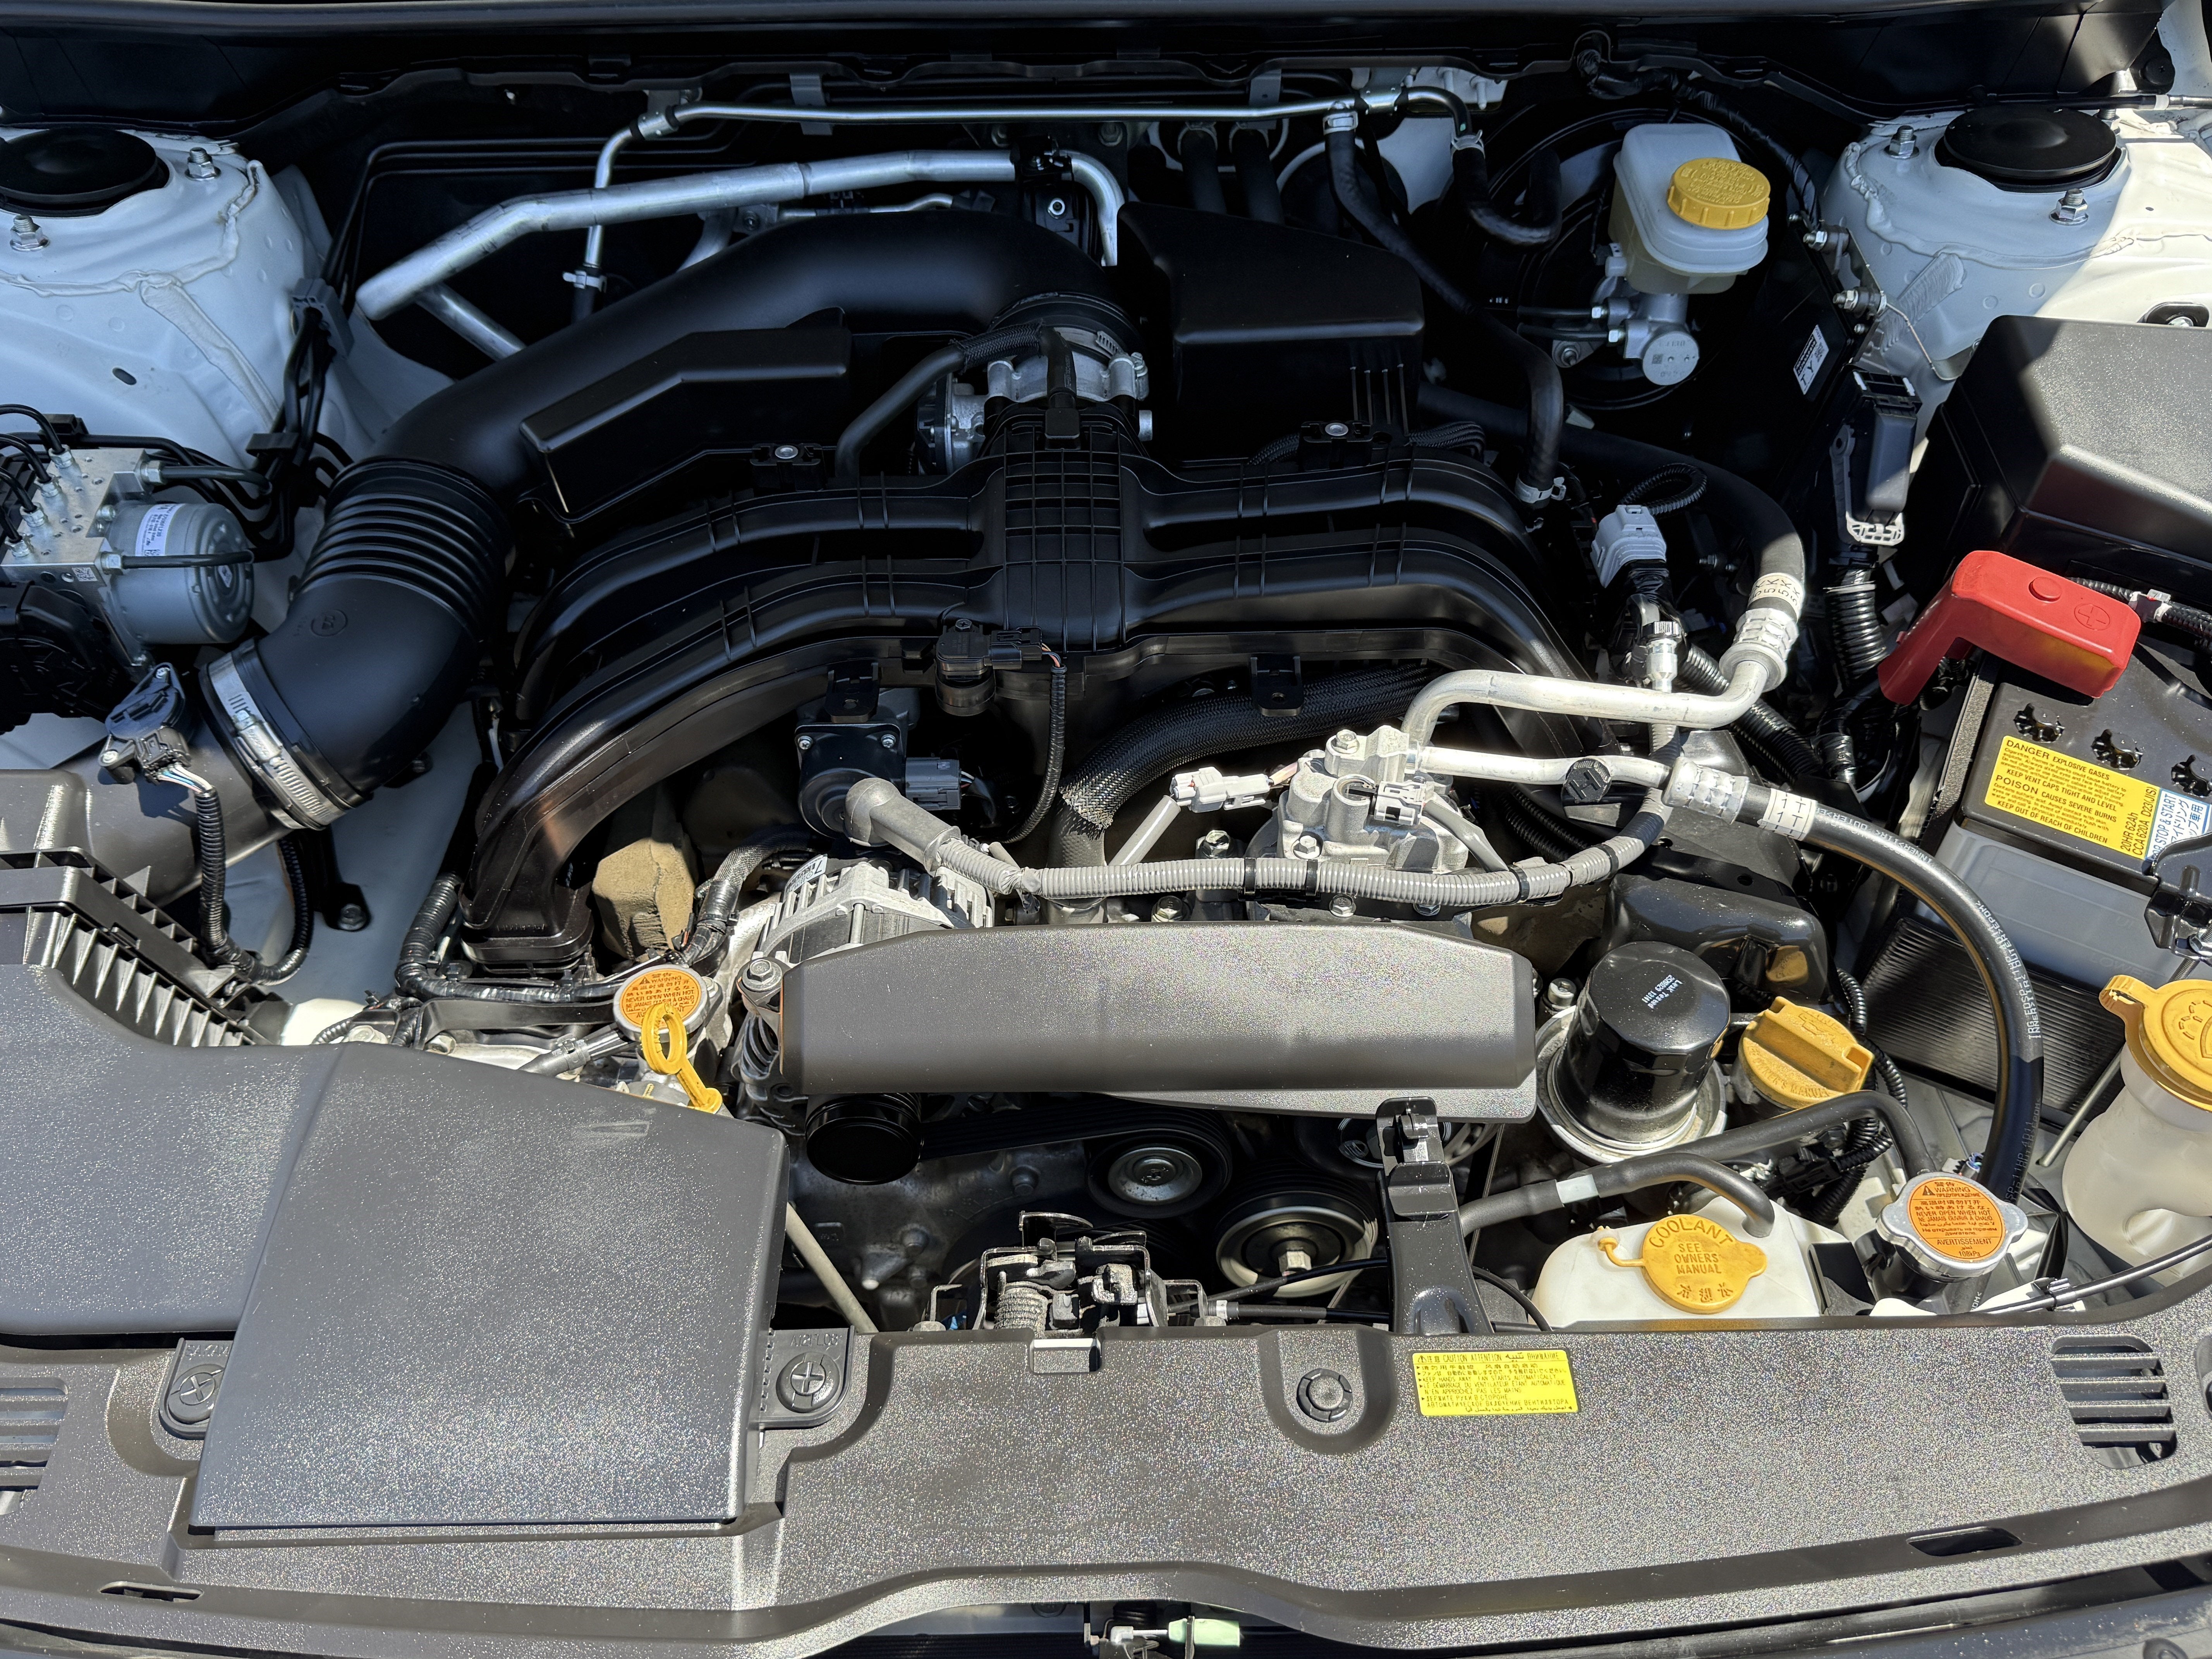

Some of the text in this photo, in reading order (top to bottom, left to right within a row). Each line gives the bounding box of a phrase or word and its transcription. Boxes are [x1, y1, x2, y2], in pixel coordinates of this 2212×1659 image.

[2006, 739, 2050, 760] DANGER
[2052, 756, 2087, 772] EXPLOSIVE
[2088, 768, 2110, 780] GASES
[1570, 769, 1601, 800] H
[1996, 774, 2039, 795] POISON
[2041, 791, 2067, 805] CAUSES
[2068, 800, 2093, 814] SEVERE
[2094, 810, 2117, 823] BURNS
[2006, 768, 2118, 812] KEEP VENT CAPS TIGHT AND LEVEL
[1997, 799, 2014, 810] KEEP
[2014, 806, 2028, 816] OUT
[2040, 815, 2062, 828] REACH
[2063, 823, 2073, 831] OF
[2073, 827, 2107, 844] CHILDREN
[2131, 785, 2157, 856] CCA 620A D23(JIS)
[2159, 817, 2171, 826] &
[2160, 793, 2177, 819] START
[2119, 811, 2139, 852] 20HR 62Ah
[2154, 823, 2170, 845] STOP
[1648, 1217, 1734, 1248] COOLANT
[1679, 1243, 1702, 1252] SEE
[1674, 1254, 1719, 1263] OWNERS
[1677, 1264, 1722, 1274] MANUAL
[1443, 1354, 1467, 1362] CAUTION
